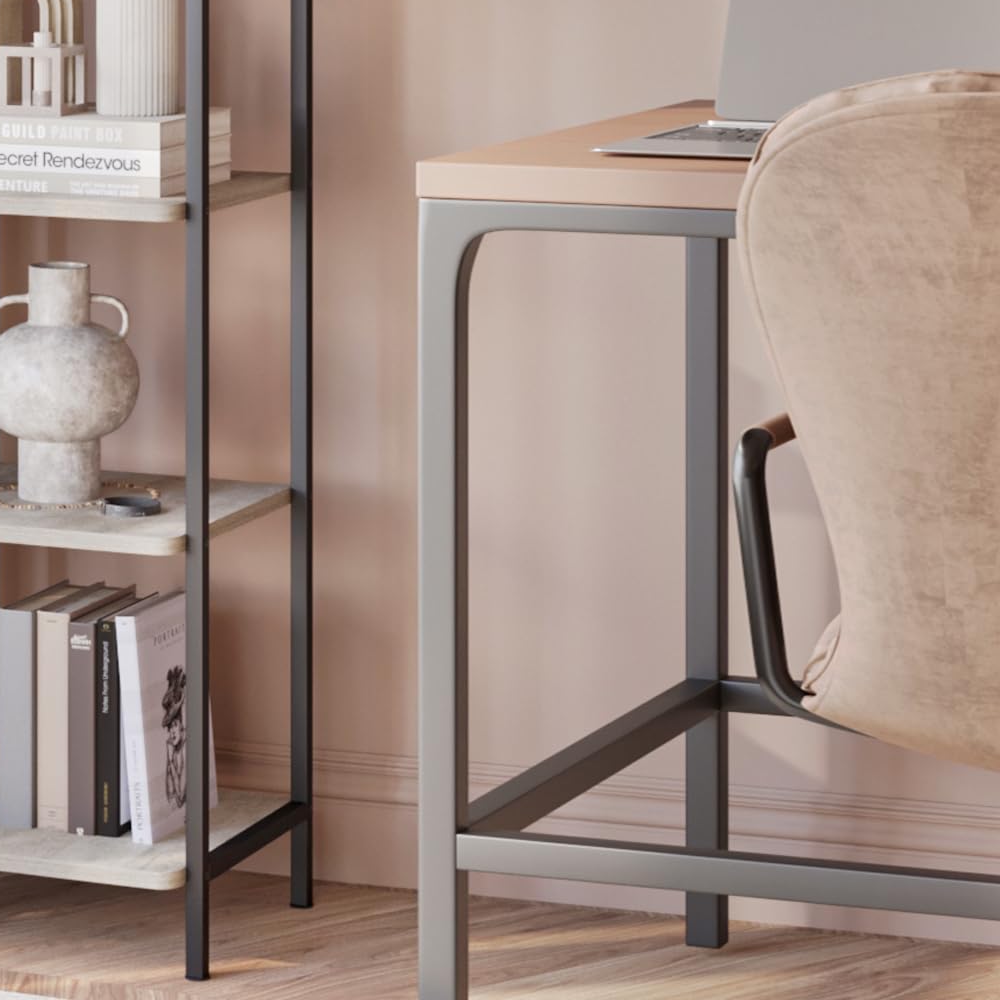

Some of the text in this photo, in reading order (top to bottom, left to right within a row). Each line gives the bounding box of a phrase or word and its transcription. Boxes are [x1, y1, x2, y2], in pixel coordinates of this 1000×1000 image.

[2, 123, 47, 139] GUILD
[51, 125, 90, 141] PAINT
[96, 127, 122, 144] BOX
[43, 151, 141, 172] Rendezvous
